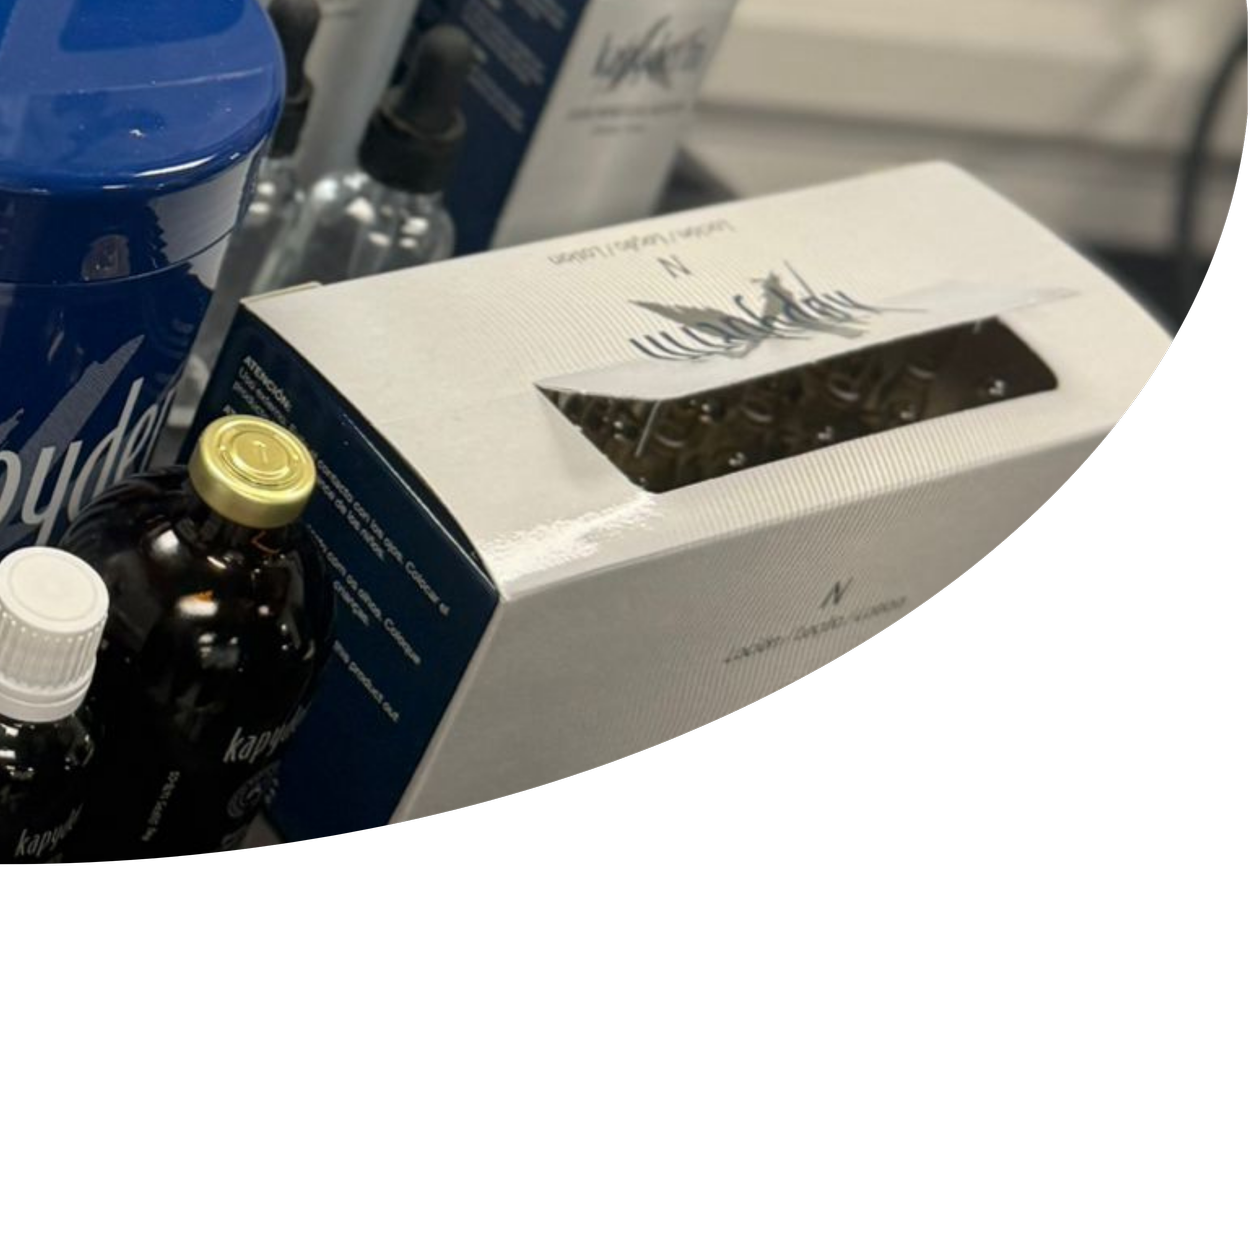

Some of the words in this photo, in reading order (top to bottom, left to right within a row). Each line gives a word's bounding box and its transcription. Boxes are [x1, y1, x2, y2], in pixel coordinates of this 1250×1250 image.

[656, 254, 693, 279] N
[405, 560, 440, 604] Colocar
[383, 617, 422, 666] Coloque
